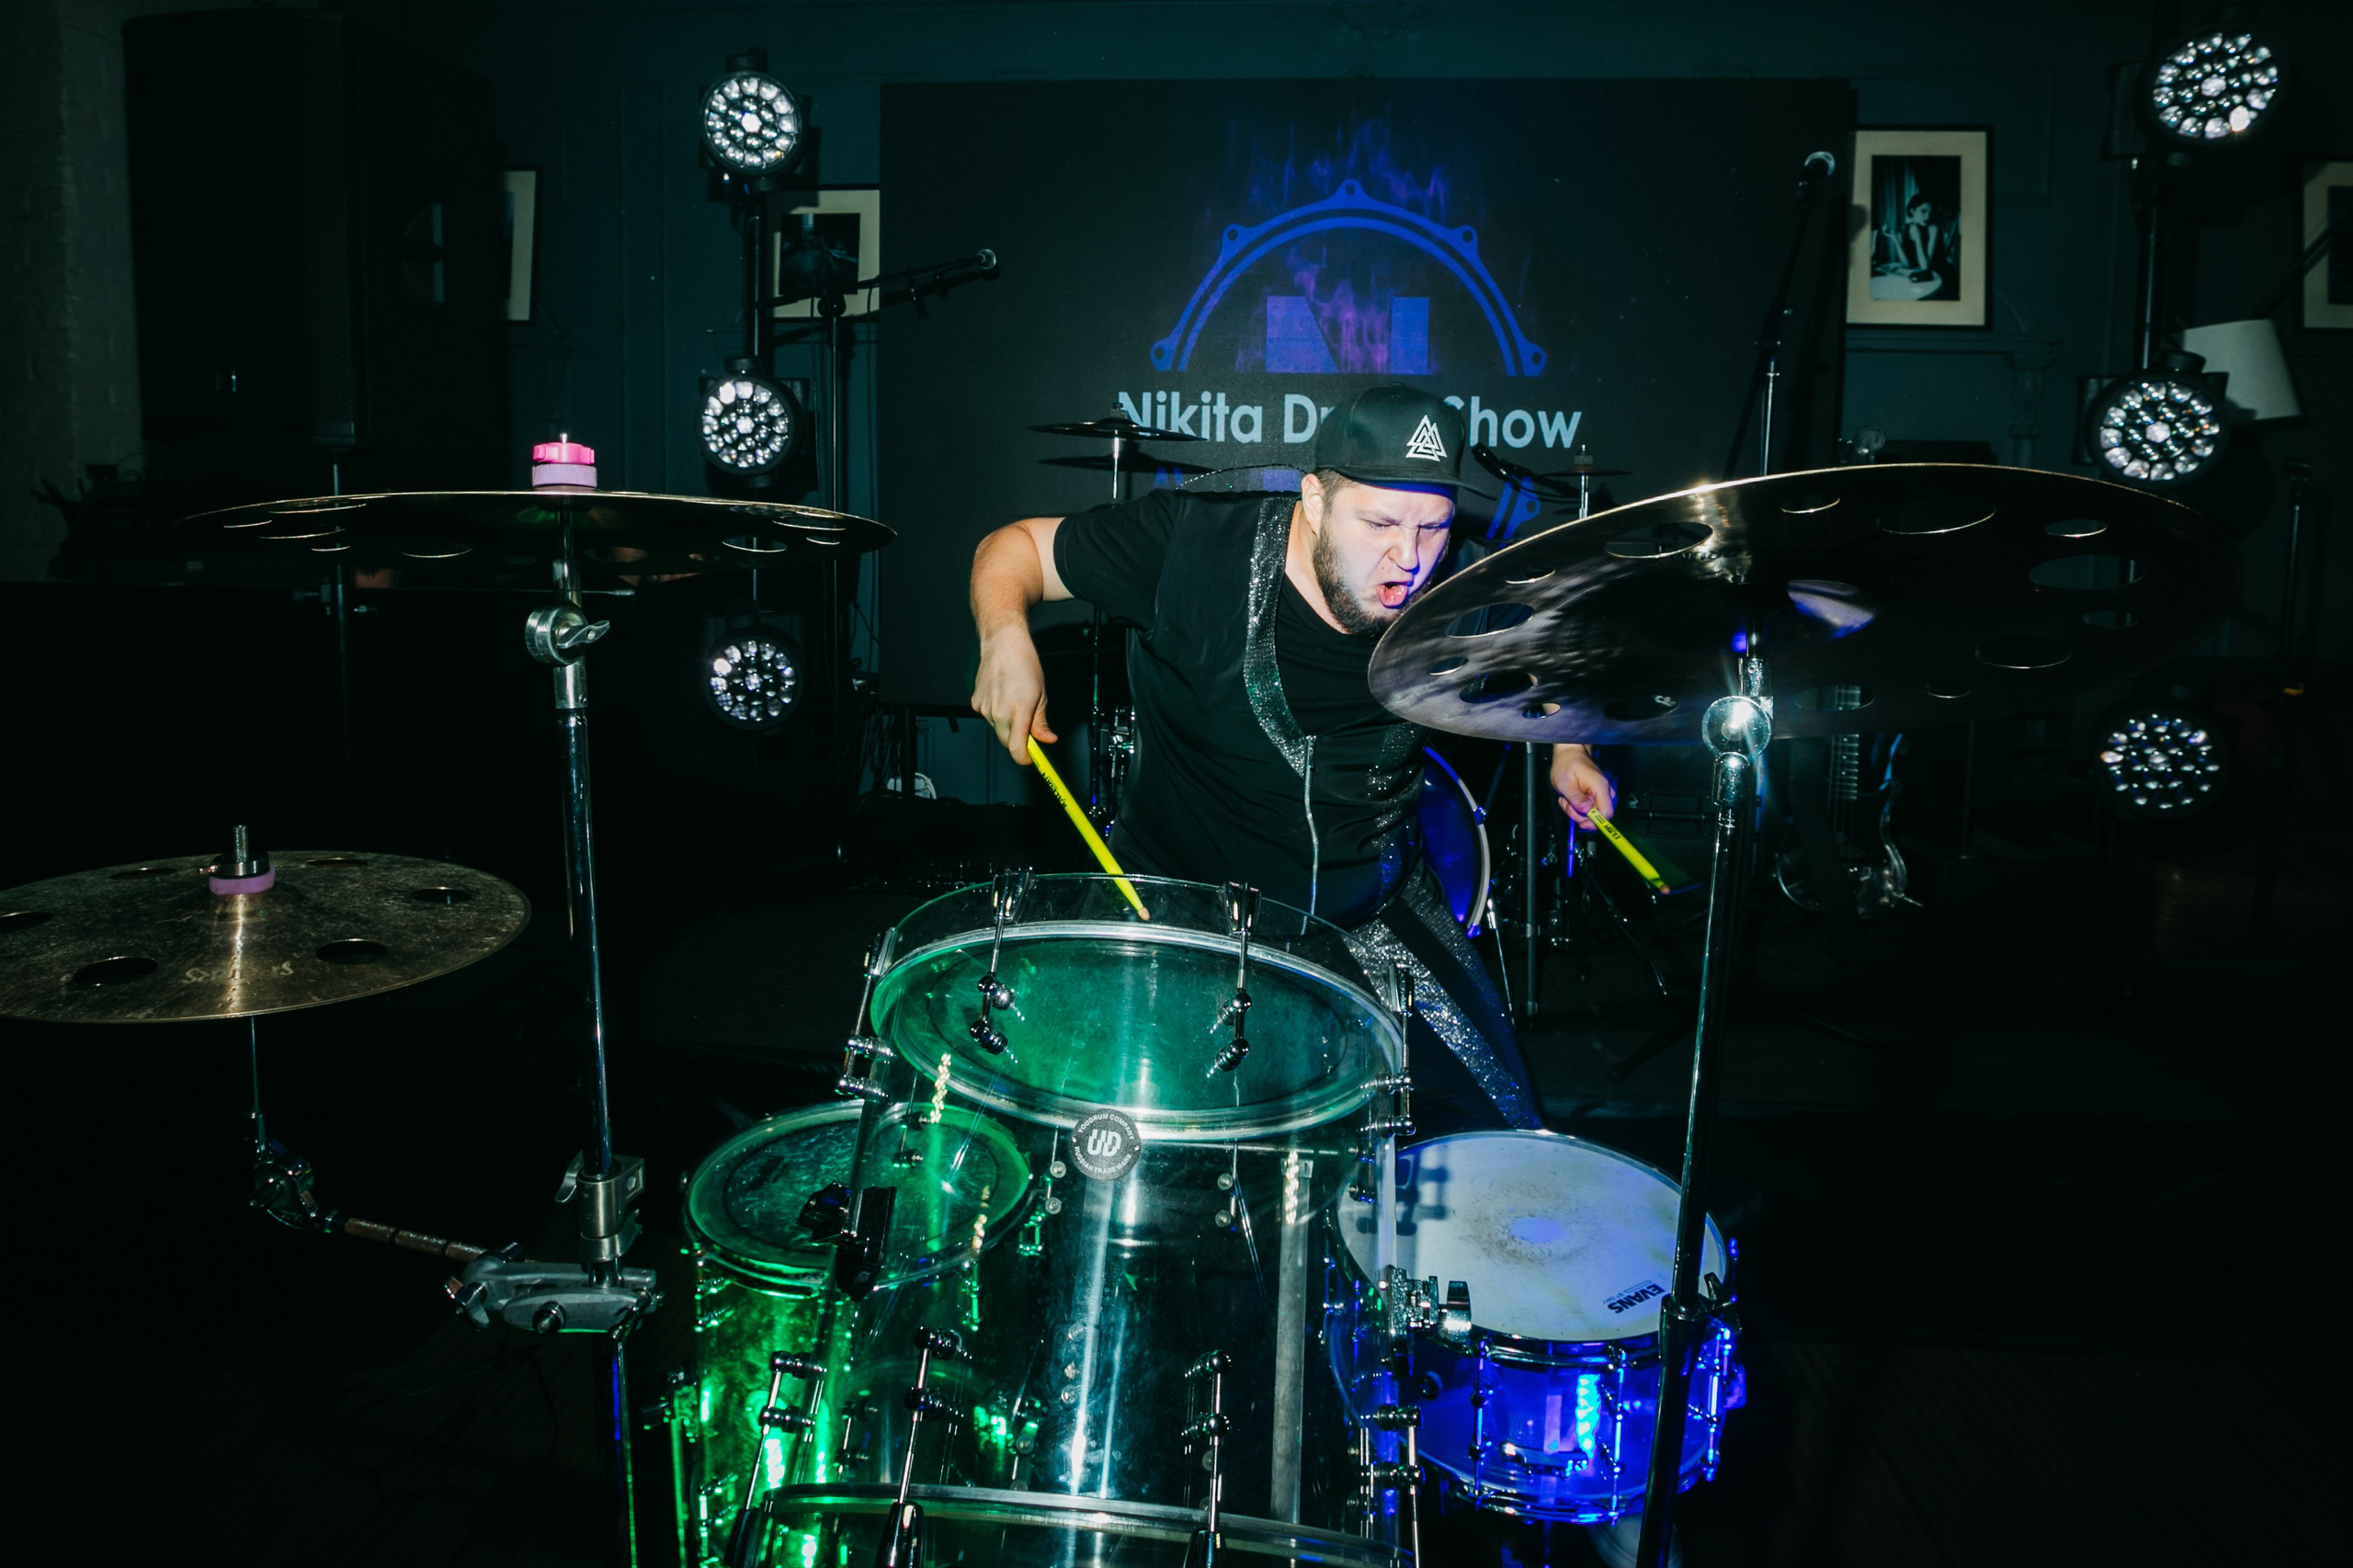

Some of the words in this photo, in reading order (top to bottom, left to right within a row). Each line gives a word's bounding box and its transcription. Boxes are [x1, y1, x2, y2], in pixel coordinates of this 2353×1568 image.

[1119, 391, 1263, 443] Nikita
[1443, 395, 1583, 449] how
[1077, 1113, 1108, 1133] YOUDRUM
[1109, 1114, 1135, 1141] COMPANY
[1074, 1146, 1095, 1172] RUSSIAN
[1094, 1166, 1118, 1175] TRADE
[1117, 1153, 1132, 1171] MARK
[1607, 1282, 1665, 1314] EVANS
